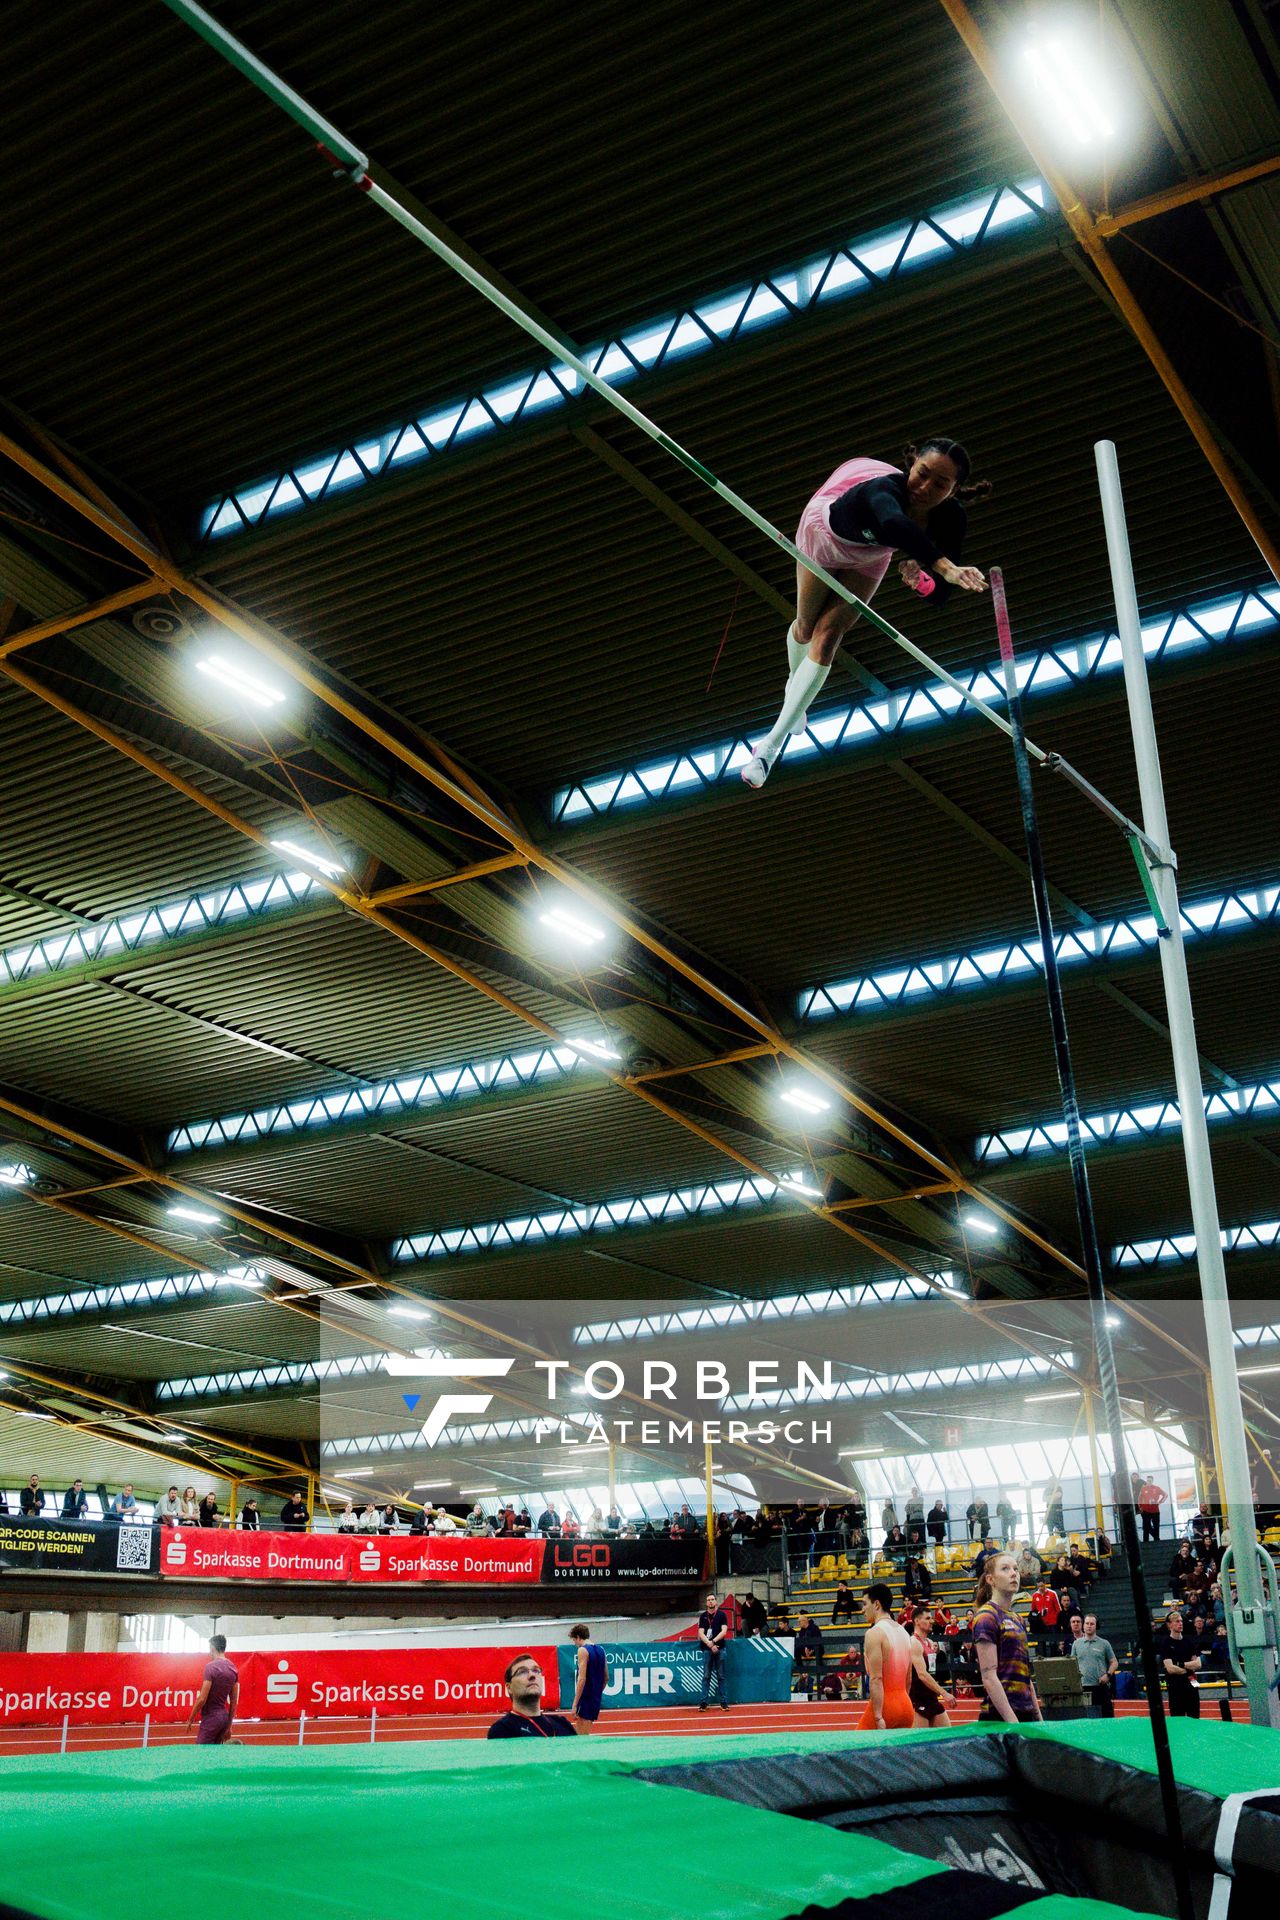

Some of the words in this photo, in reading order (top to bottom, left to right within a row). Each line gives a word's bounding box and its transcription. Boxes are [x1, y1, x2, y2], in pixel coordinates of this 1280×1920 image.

[46, 1530, 96, 1543] SCANNEN
[37, 1543, 84, 1554] WERDEN!
[554, 1544, 611, 1567] LGO
[193, 1550, 261, 1568] Sparkasse
[268, 1552, 344, 1570] Dortmund
[388, 1556, 459, 1574] Sparkasse
[464, 1557, 533, 1573] Dortmund
[554, 1568, 611, 1577] DORTMUND
[617, 1566, 698, 1578] www.lgo-dortmund.de
[310, 1679, 425, 1708] Sparkasse
